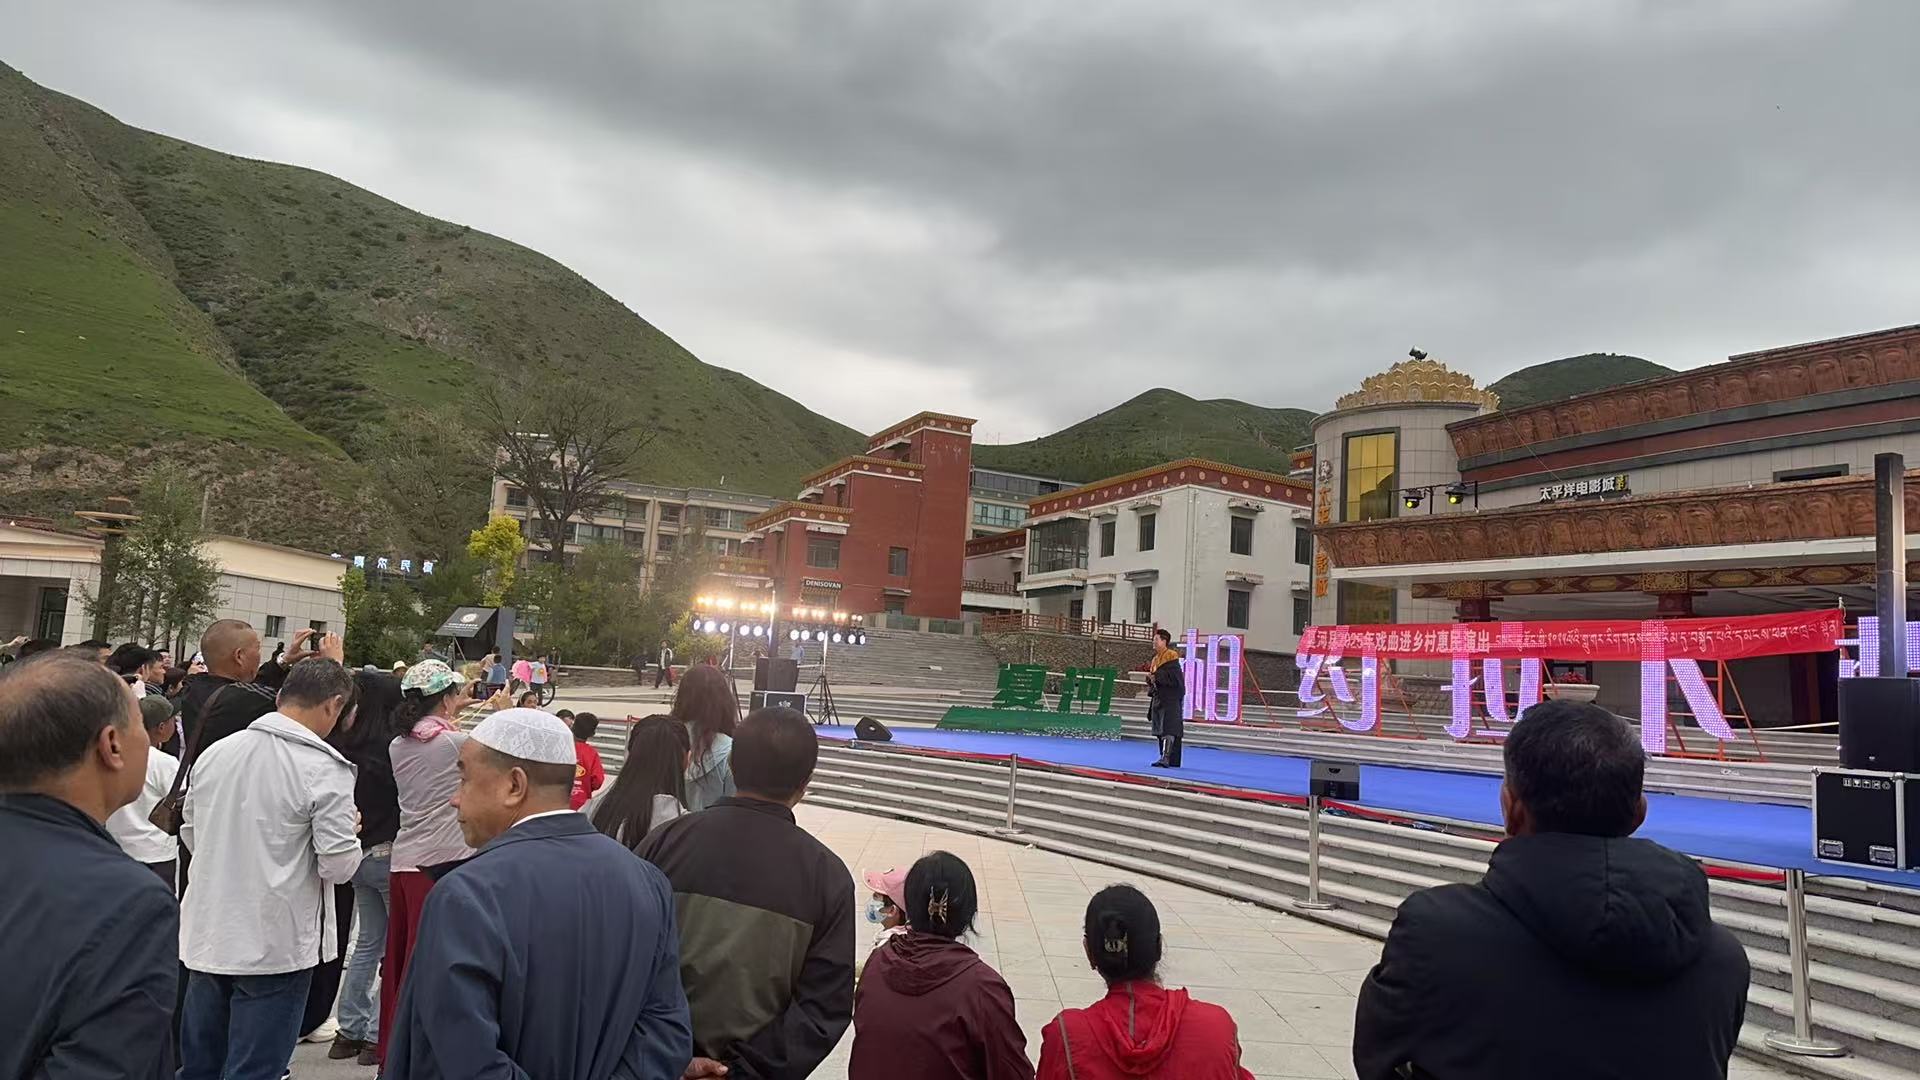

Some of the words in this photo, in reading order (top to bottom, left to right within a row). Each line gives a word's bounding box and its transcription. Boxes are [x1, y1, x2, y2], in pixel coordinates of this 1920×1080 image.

[1540, 476, 1615, 500] 太平洋电影城
[806, 580, 841, 589] DENISOVAN
